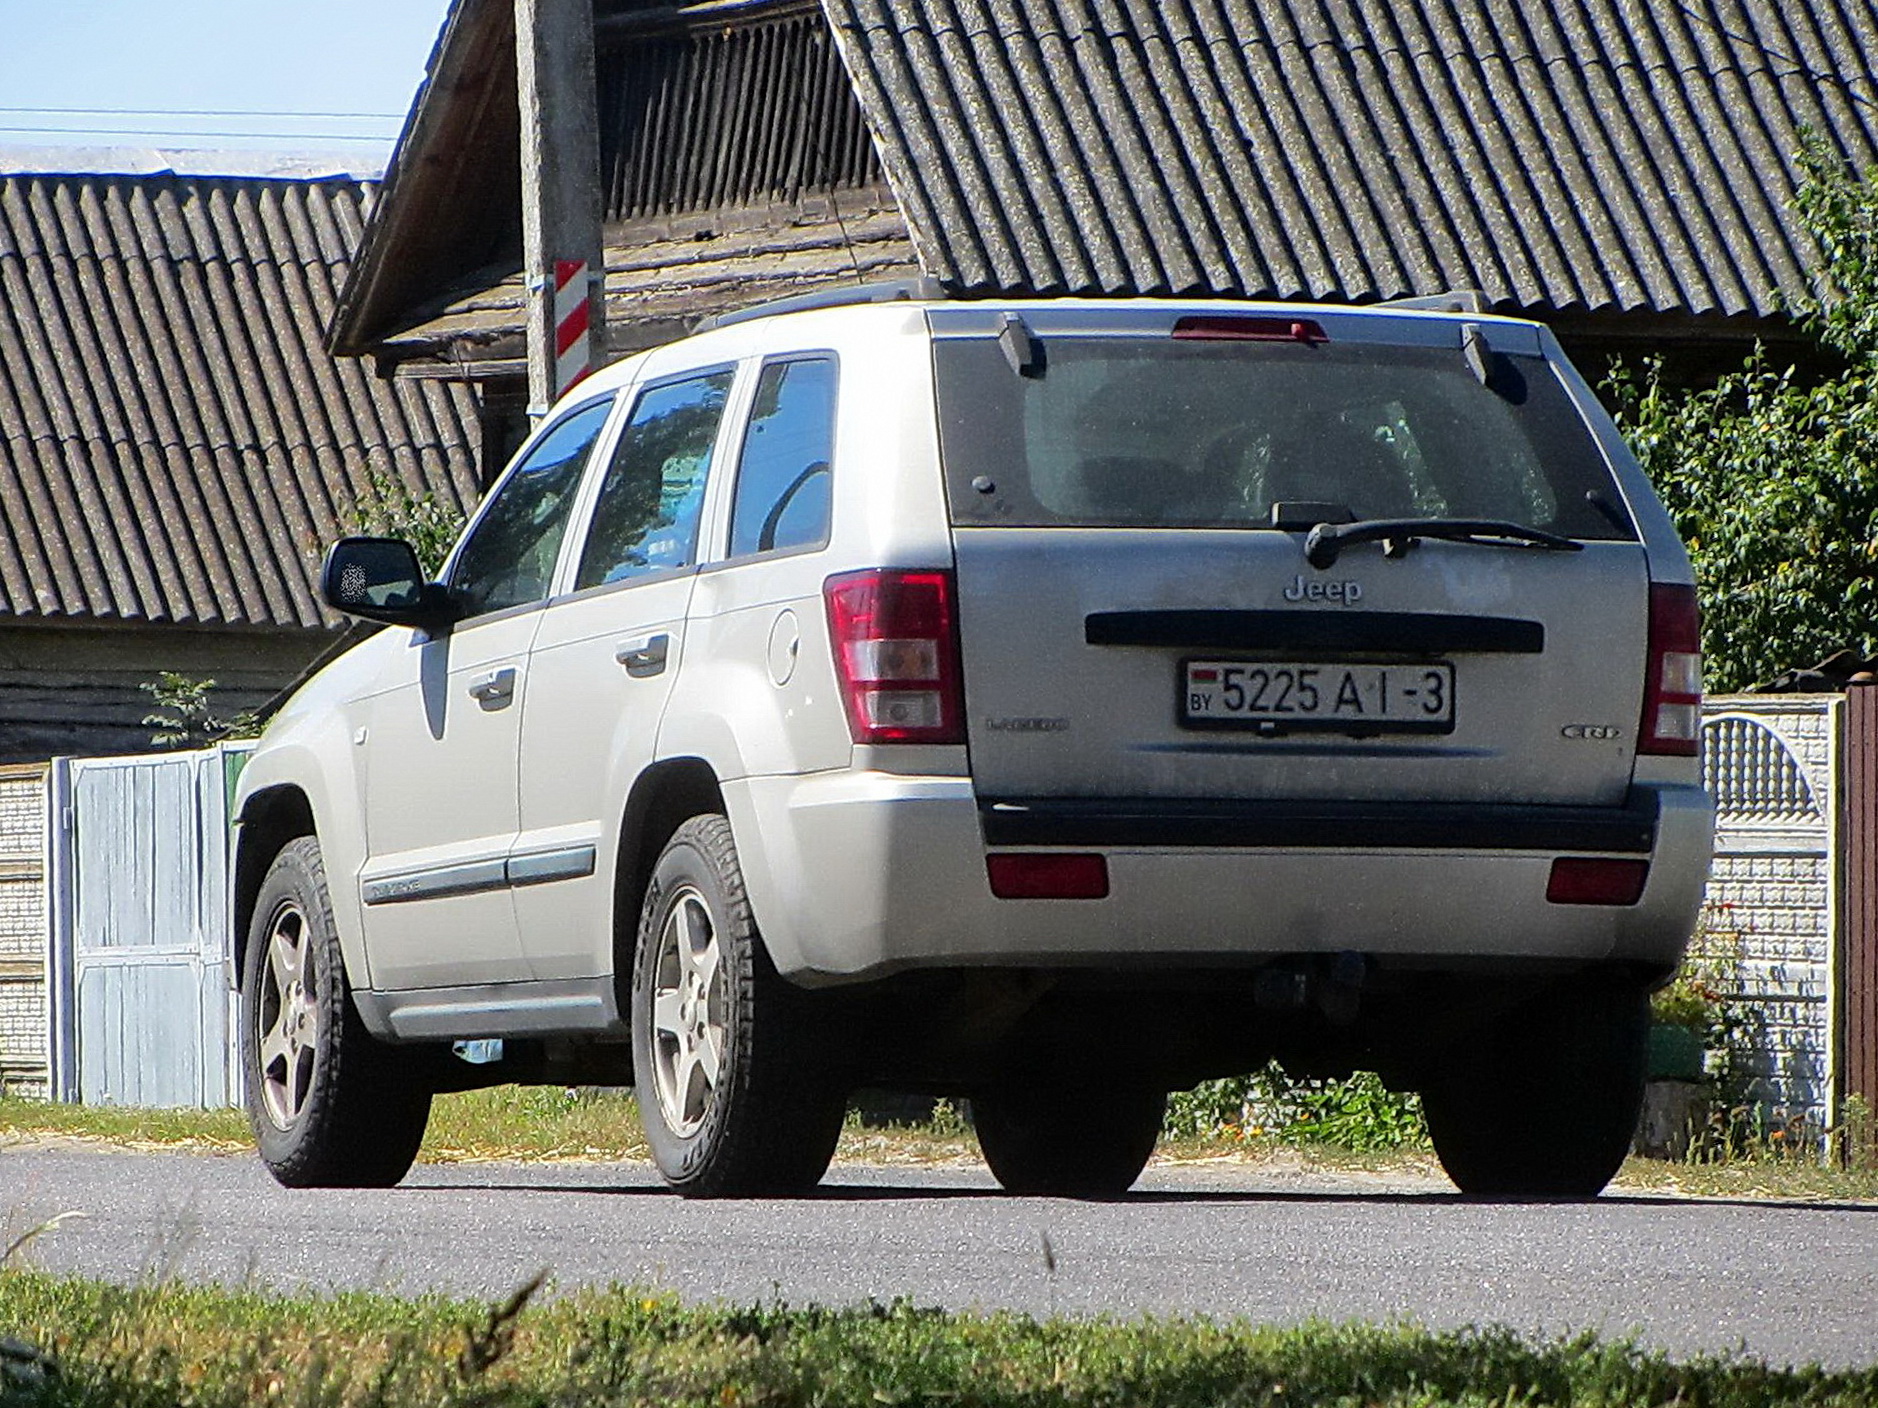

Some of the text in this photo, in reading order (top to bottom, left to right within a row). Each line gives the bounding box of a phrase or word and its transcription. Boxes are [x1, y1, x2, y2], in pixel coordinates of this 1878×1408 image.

[1284, 575, 1362, 606] Jeep
[1190, 693, 1212, 711] BY
[1221, 669, 1320, 712] 5225
